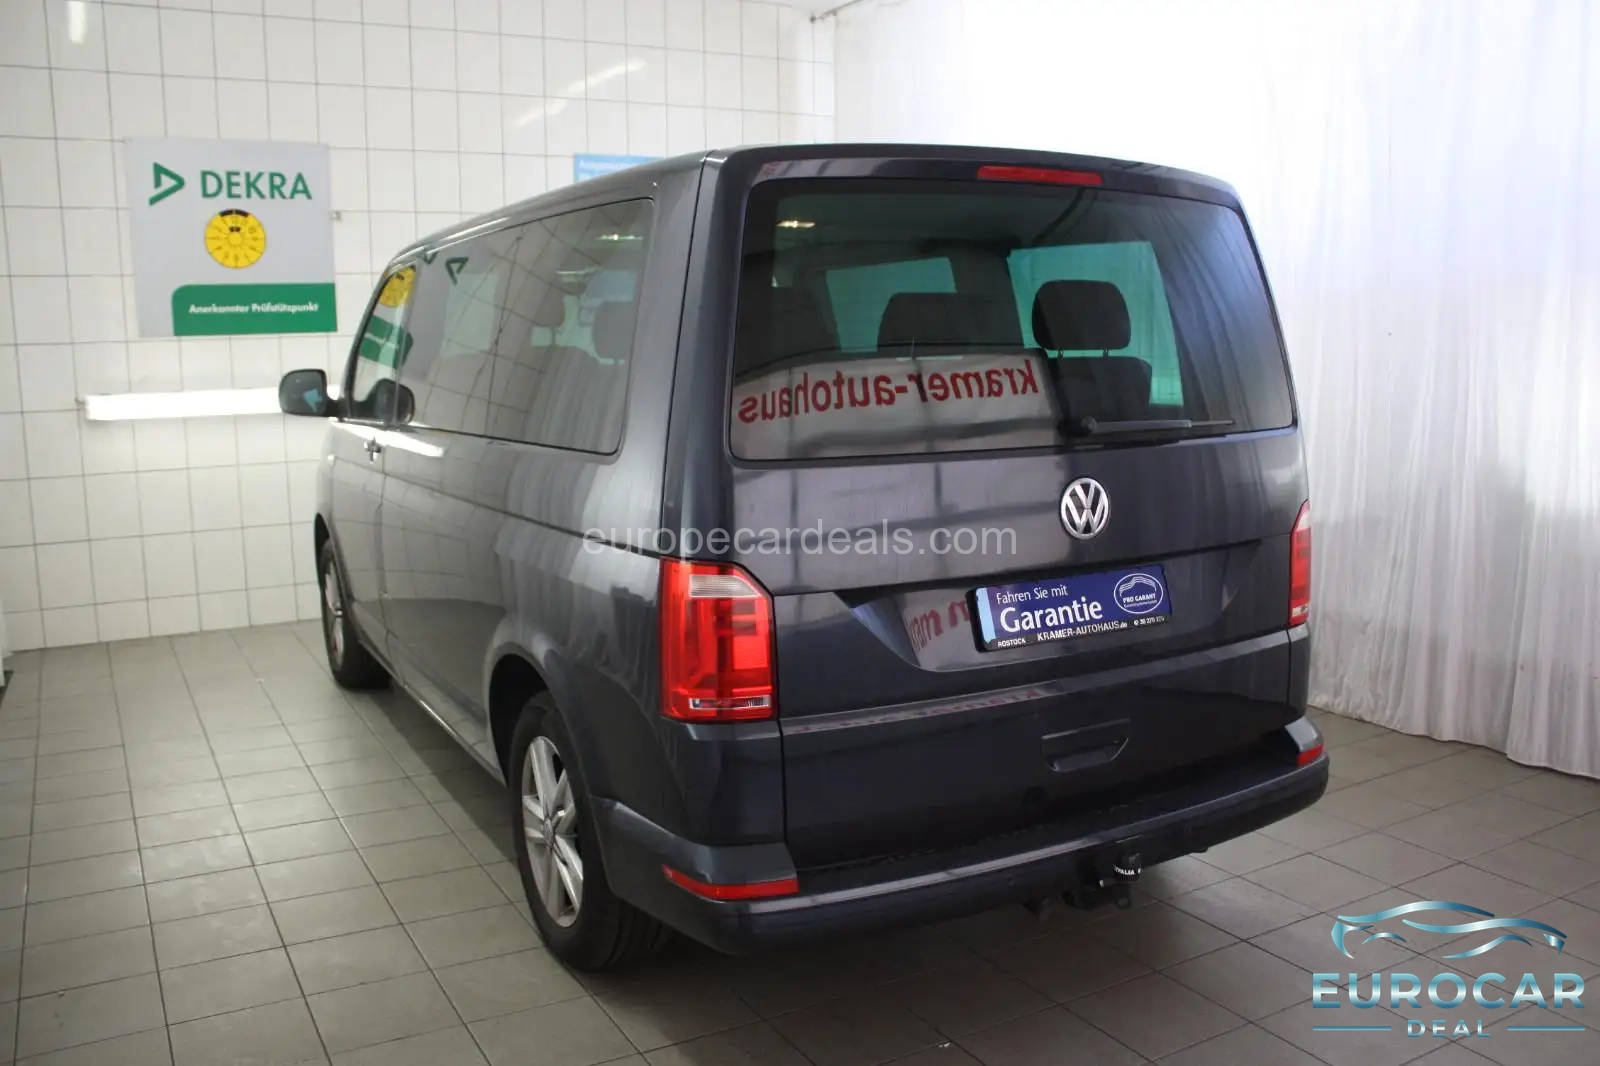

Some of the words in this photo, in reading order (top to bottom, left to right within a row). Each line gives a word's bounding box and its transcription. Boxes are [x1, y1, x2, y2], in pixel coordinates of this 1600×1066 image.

[201, 169, 312, 200] DEKRA
[996, 590, 1031, 605] Fahren
[1033, 586, 1048, 599] Sie
[1051, 584, 1068, 597] mit
[1000, 596, 1103, 633] Garantie
[998, 637, 1026, 647] ROSTOCK
